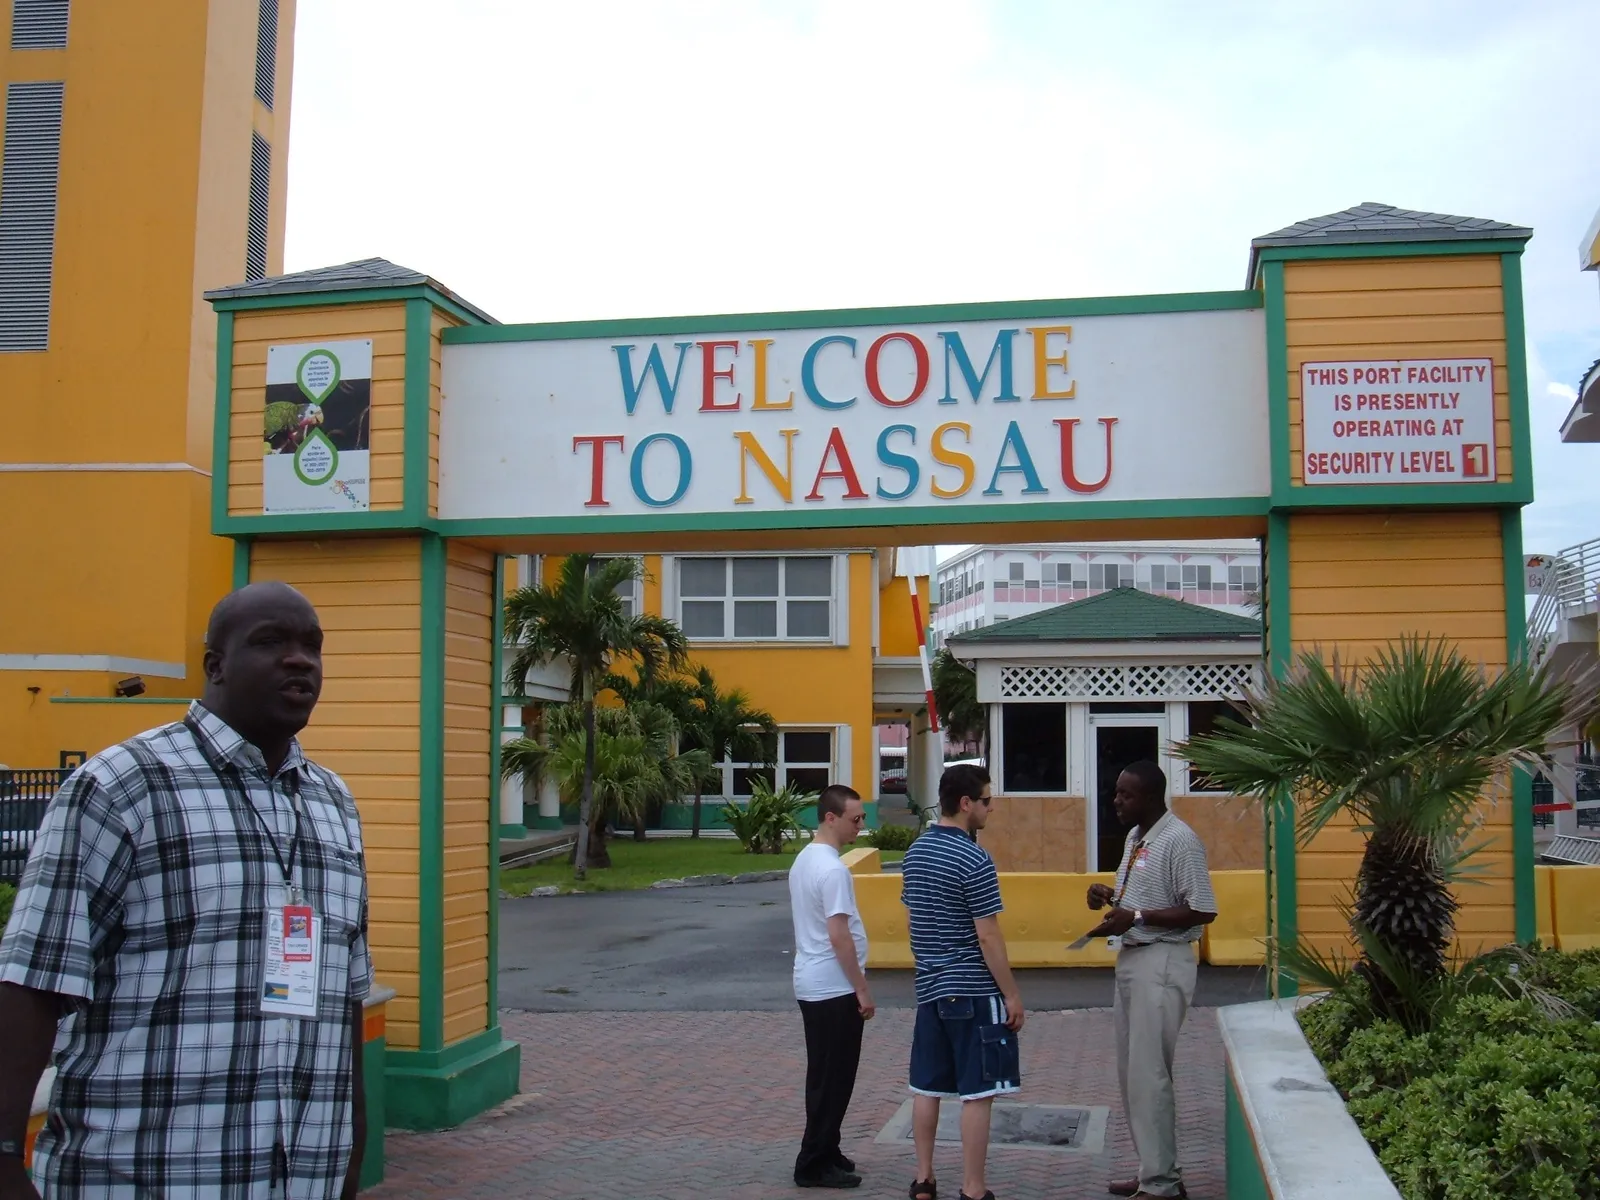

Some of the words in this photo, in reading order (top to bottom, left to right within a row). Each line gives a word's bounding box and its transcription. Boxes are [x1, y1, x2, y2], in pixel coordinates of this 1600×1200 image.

[611, 326, 1077, 415] WELCOME
[1307, 368, 1348, 385] THIS
[1353, 367, 1402, 384] PORT
[1407, 365, 1486, 383] FACILITY
[1334, 394, 1352, 412] IS
[1356, 392, 1460, 411] PRESENTLY
[1333, 419, 1436, 438] OPERATING
[1442, 418, 1464, 436] AT
[572, 432, 693, 507] TO
[733, 416, 1119, 505] NASSAU
[1307, 451, 1395, 475] SECURITY
[1400, 450, 1455, 474] LEVEL
[1467, 445, 1483, 474] 1
